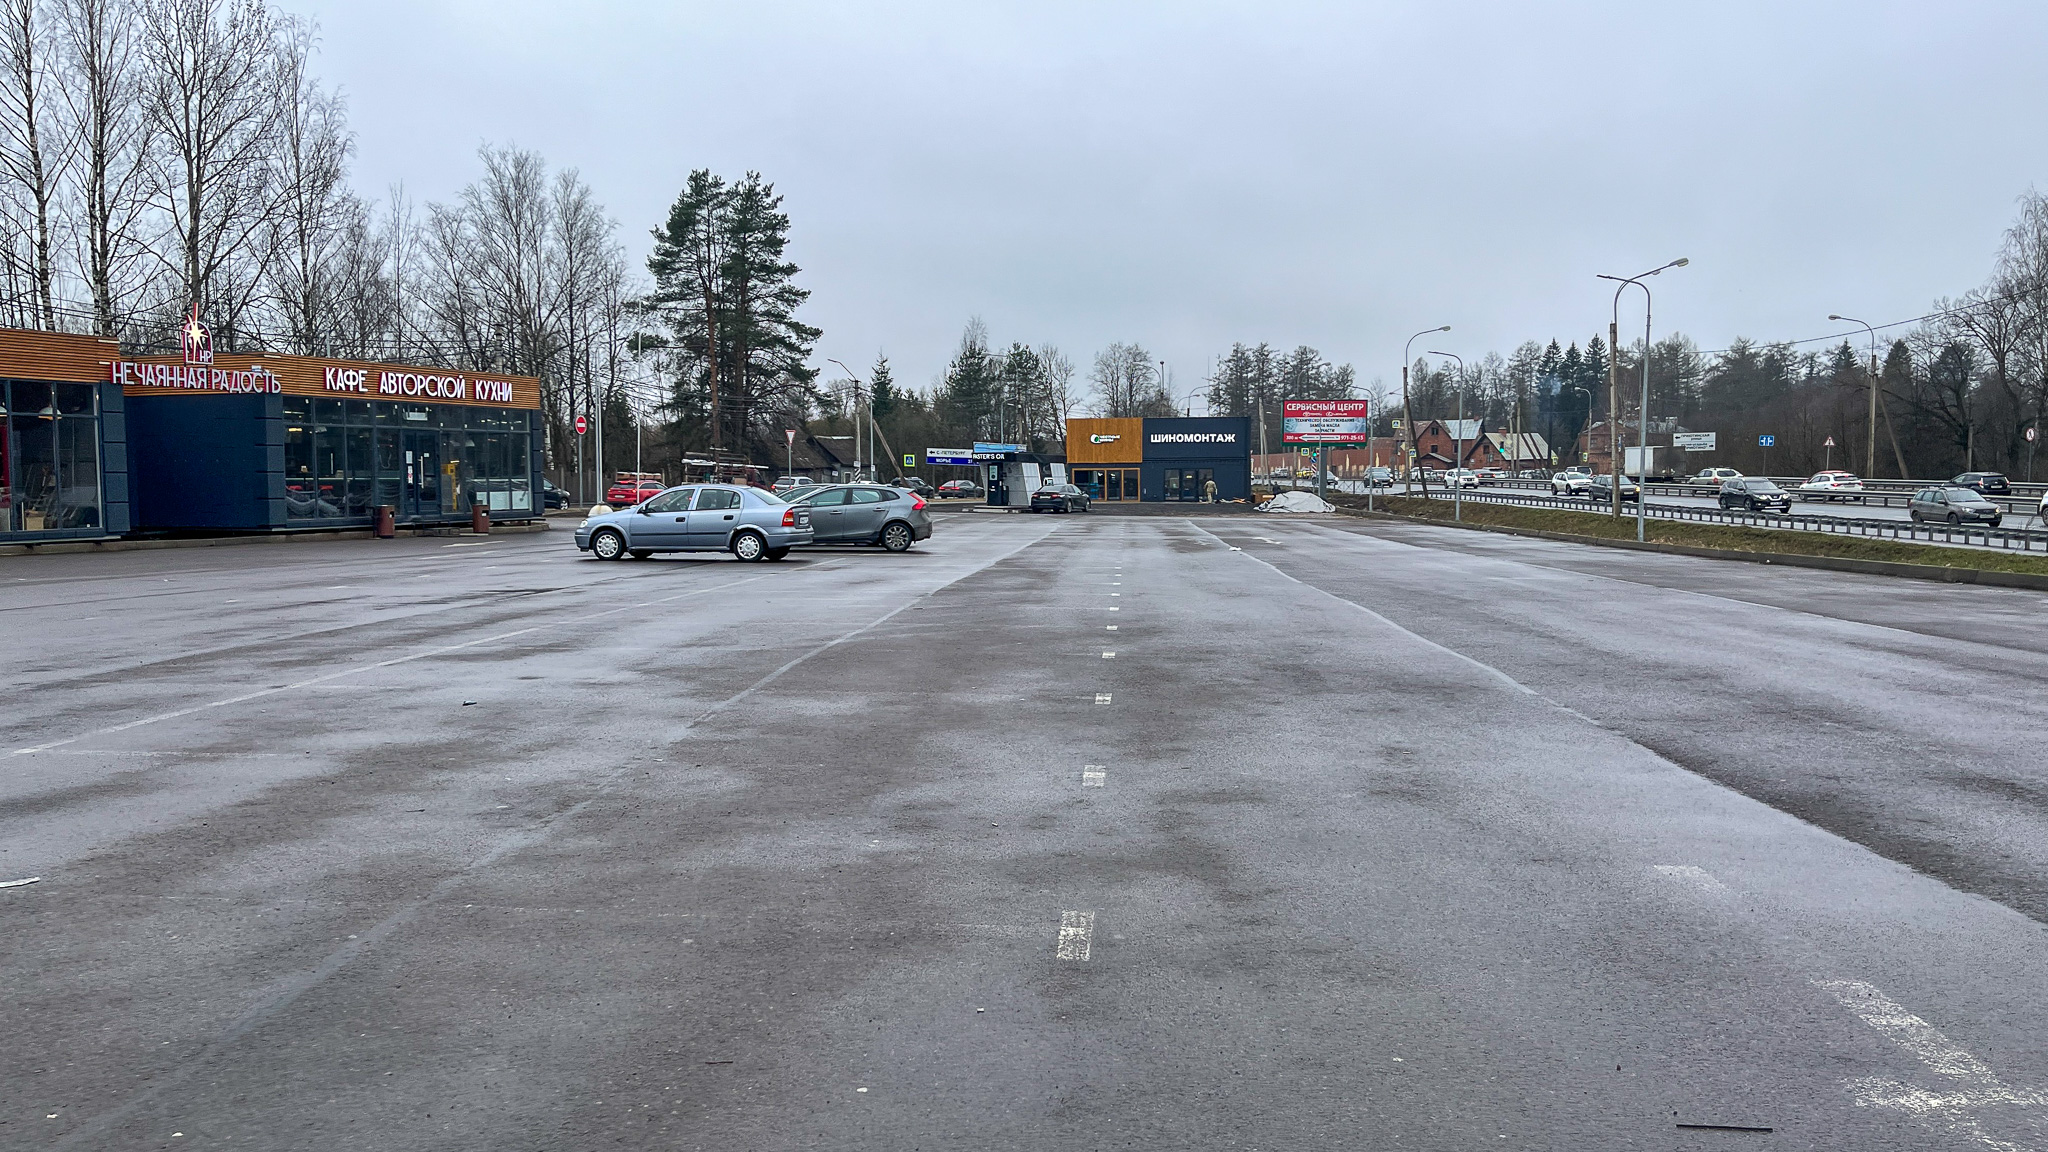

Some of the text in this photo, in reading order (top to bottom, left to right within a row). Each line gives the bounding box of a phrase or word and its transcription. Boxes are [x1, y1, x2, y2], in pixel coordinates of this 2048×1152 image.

[111, 361, 281, 393] НЕЧАЯННАЯ РАДОСТЬ
[325, 367, 513, 401] КАФЕ АВТОРСКОЙ КУХНИ
[1287, 402, 1364, 412] СЕРВИСНЫЙ ЦЕНТР
[1150, 433, 1236, 443] ШИНОМОНТАЖ
